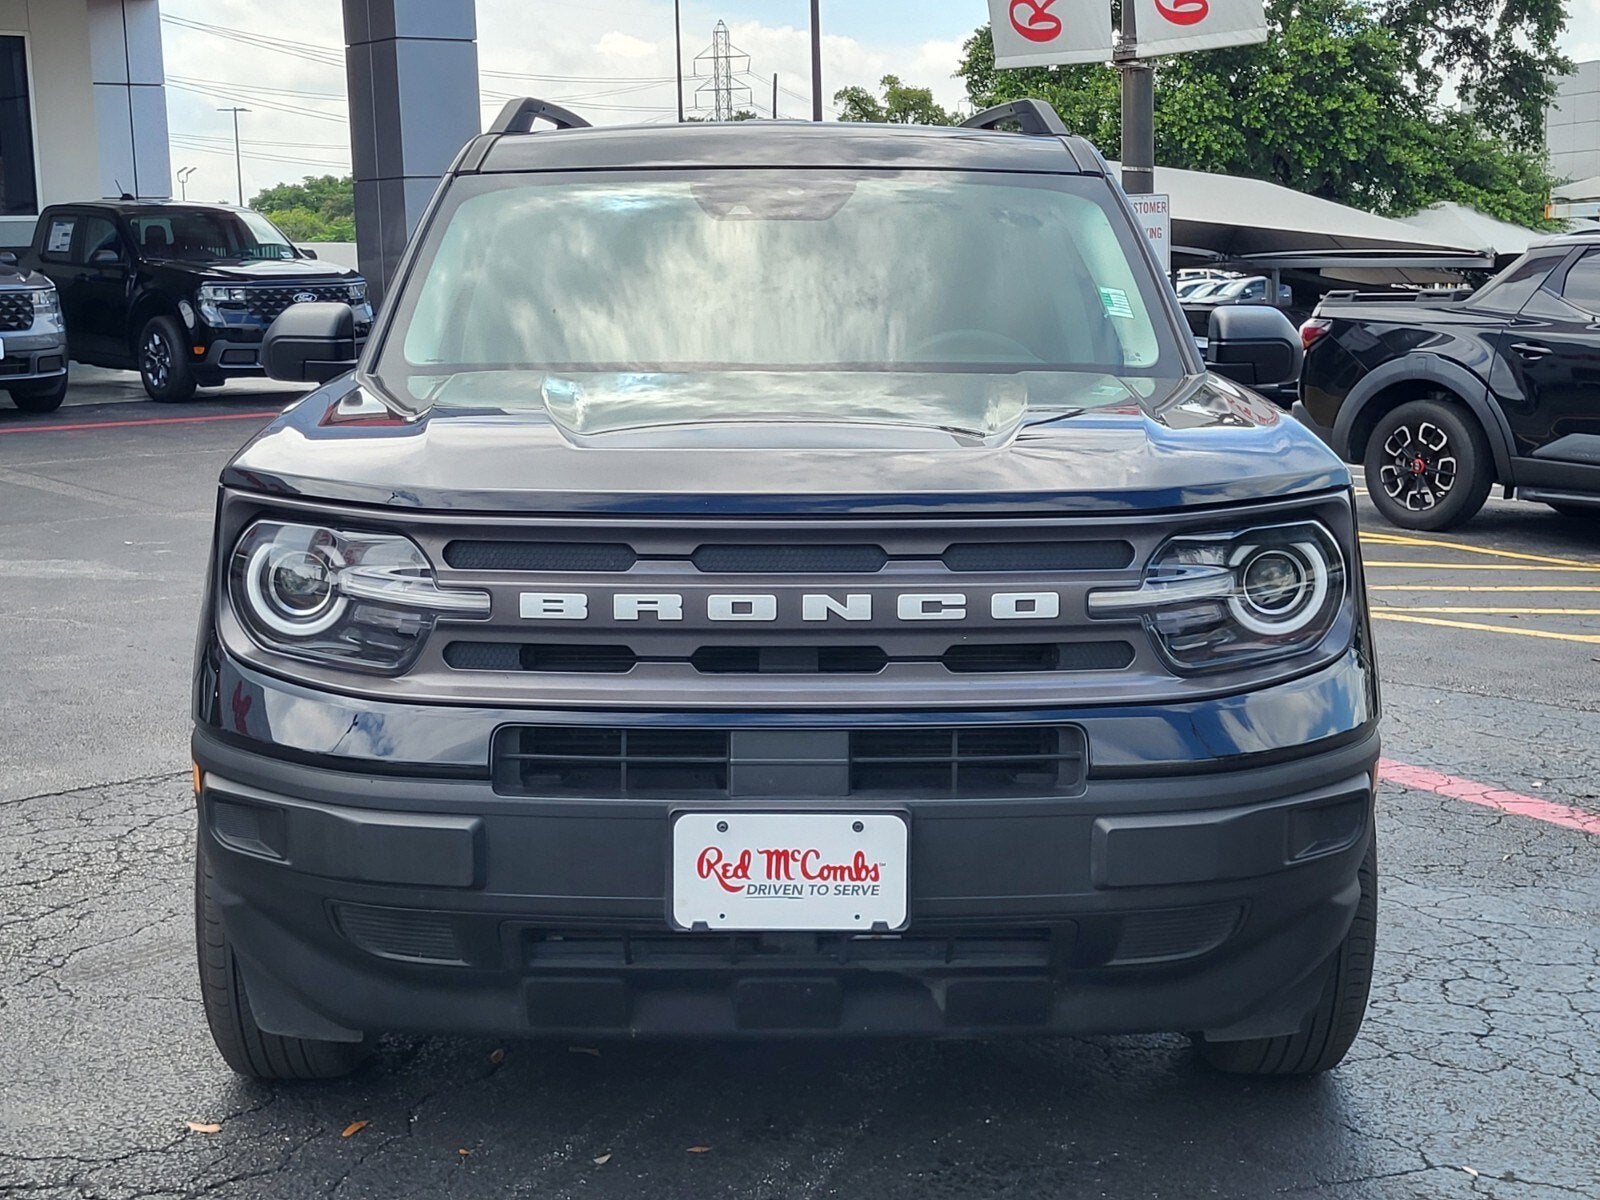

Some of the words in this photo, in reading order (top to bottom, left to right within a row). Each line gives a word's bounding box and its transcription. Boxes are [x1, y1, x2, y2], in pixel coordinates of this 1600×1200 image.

[1131, 202, 1167, 213] STOMER
[519, 592, 1060, 621] BRONCO
[697, 846, 752, 892] Red
[757, 848, 880, 882] McCombs
[746, 884, 803, 895] DRIVEN
[809, 884, 829, 896] TO
[833, 885, 880, 896] SERVE
